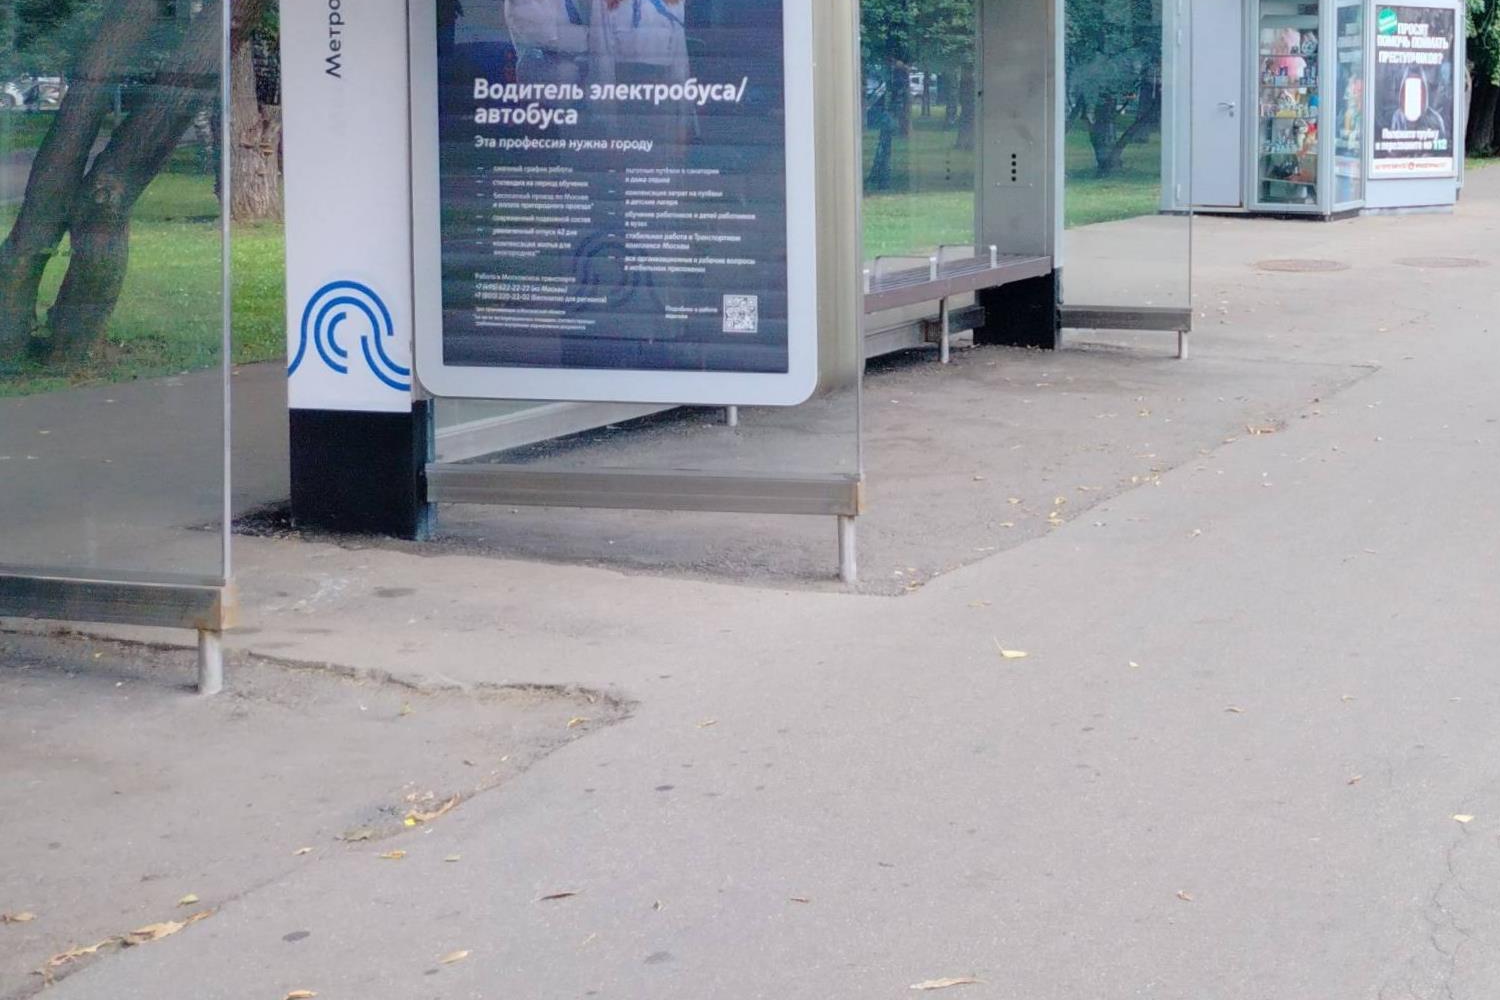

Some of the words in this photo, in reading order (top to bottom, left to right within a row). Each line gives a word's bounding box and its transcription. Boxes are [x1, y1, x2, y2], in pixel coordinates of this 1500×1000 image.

[473, 77, 584, 104] Водитель
[589, 76, 748, 106] электробуса/
[474, 102, 578, 130] автобуса
[474, 135, 496, 149] Эта
[499, 135, 566, 151] профессия
[568, 138, 608, 151] нужна
[610, 139, 653, 152] городу
